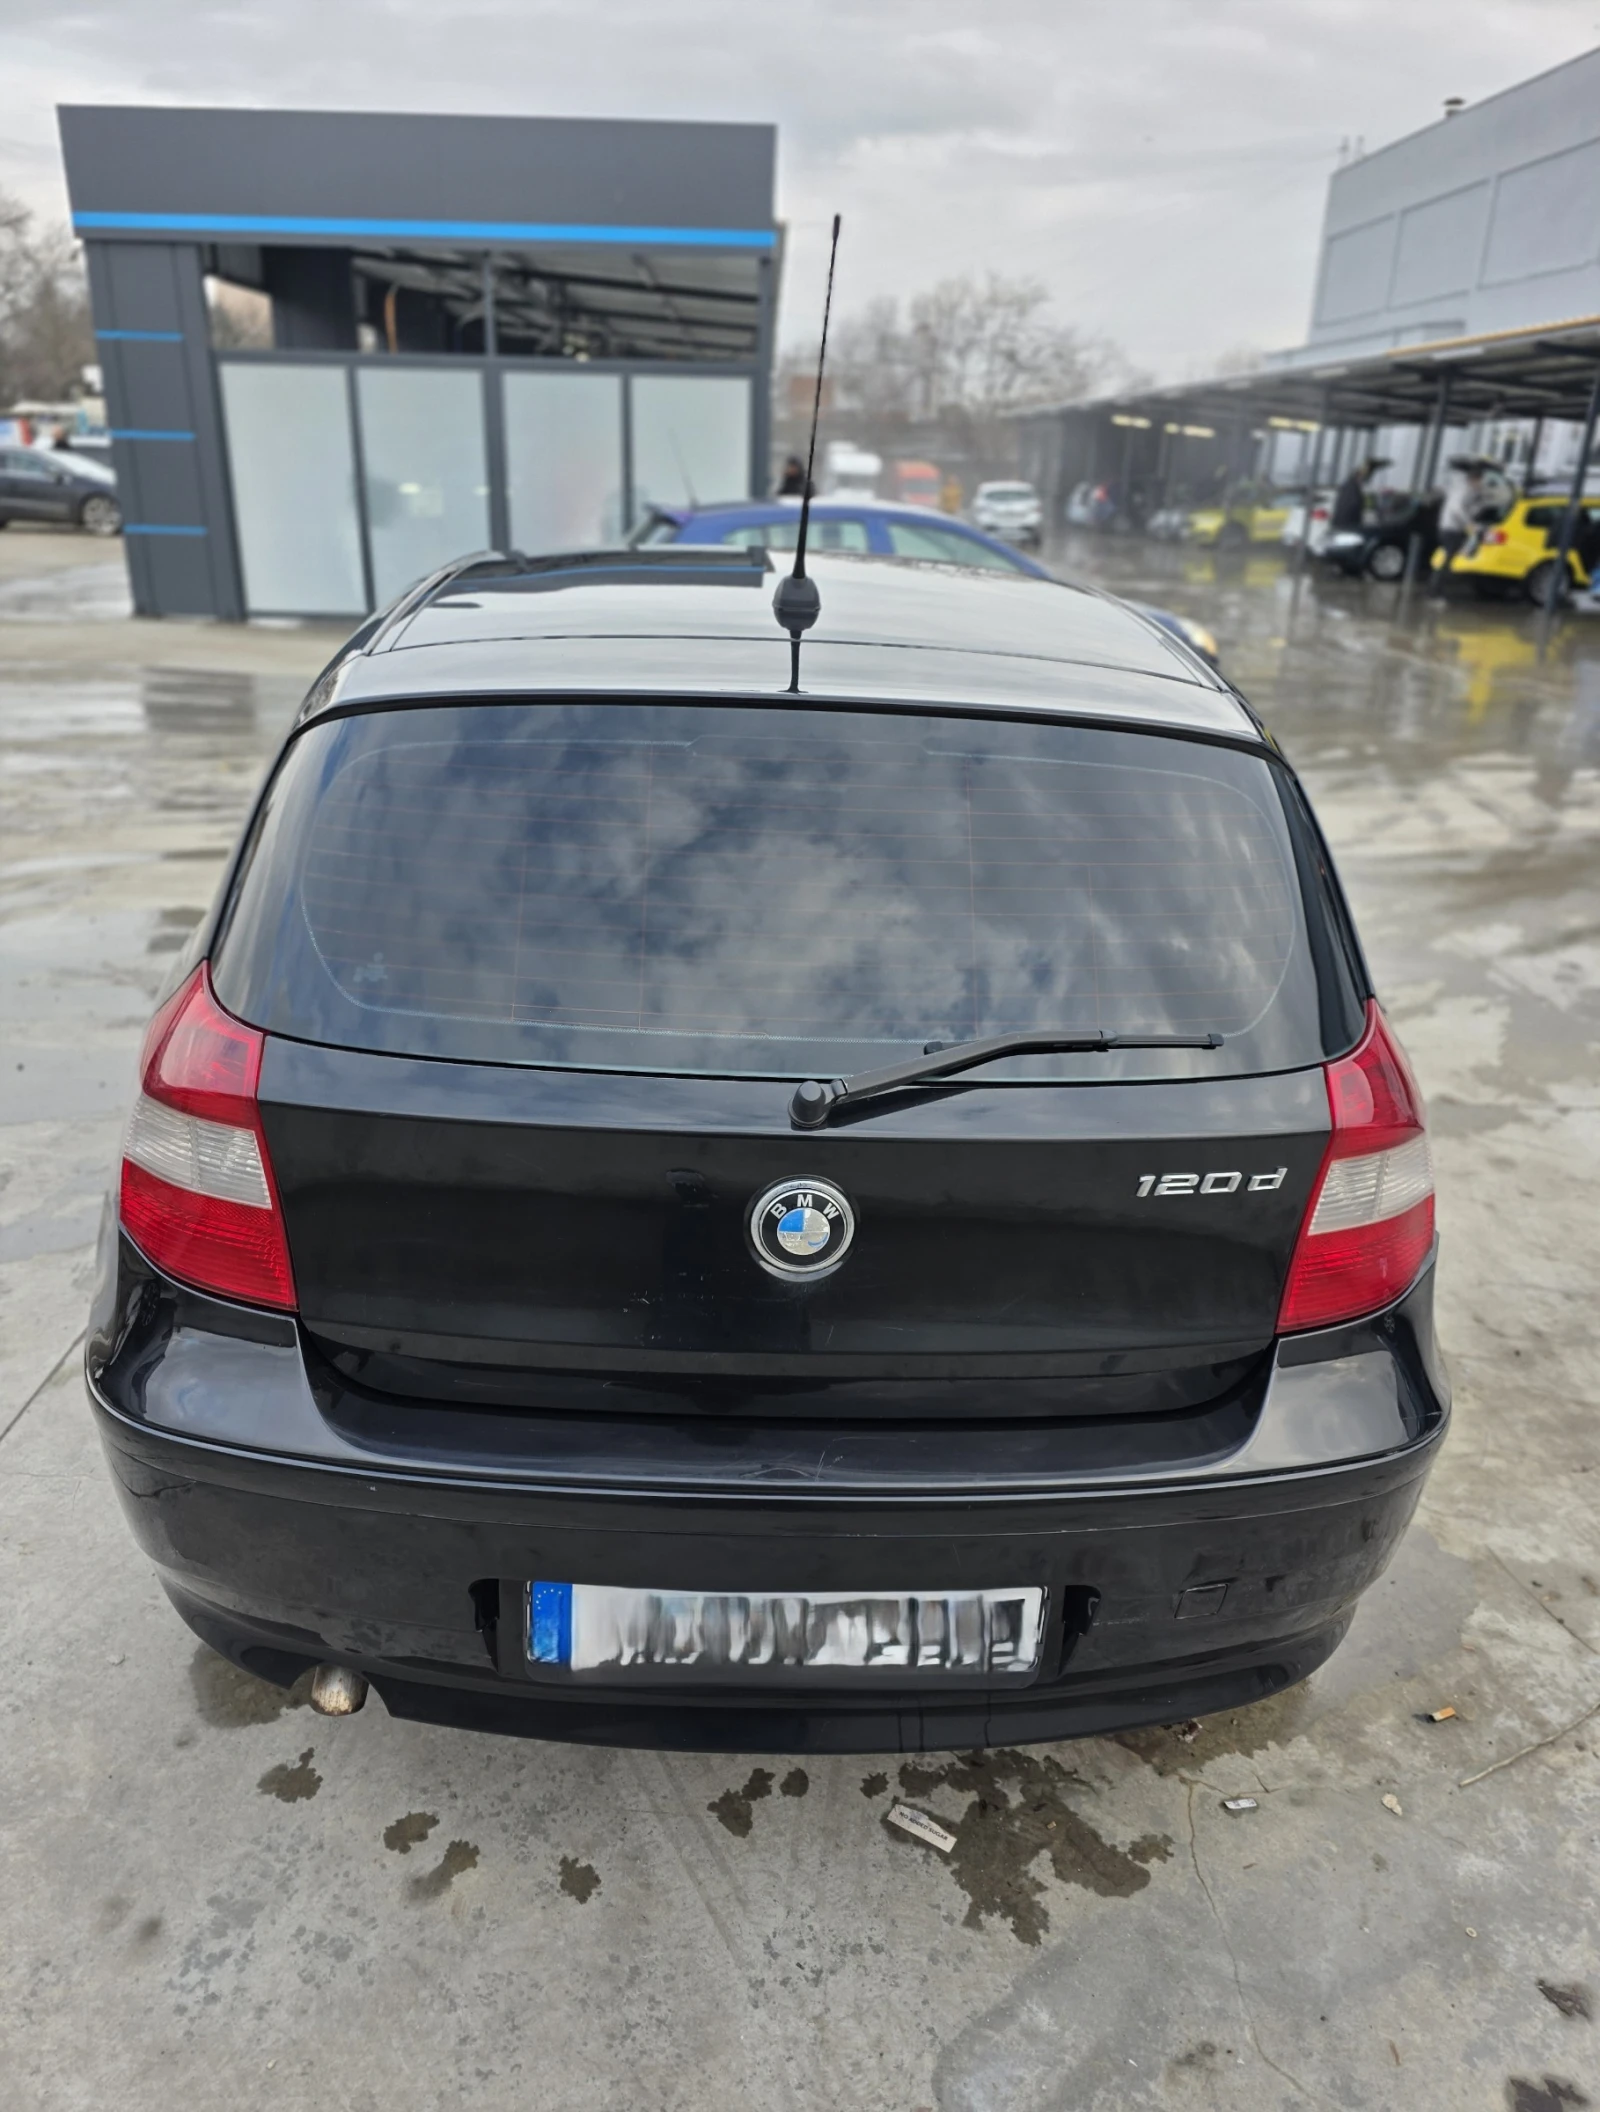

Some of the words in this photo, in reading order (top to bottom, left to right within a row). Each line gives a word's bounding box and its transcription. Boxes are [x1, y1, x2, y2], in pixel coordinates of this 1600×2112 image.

[770, 1194, 839, 1219] BMW
[909, 1817, 929, 1830] ADDED
[928, 1827, 949, 1841] SUGAR
